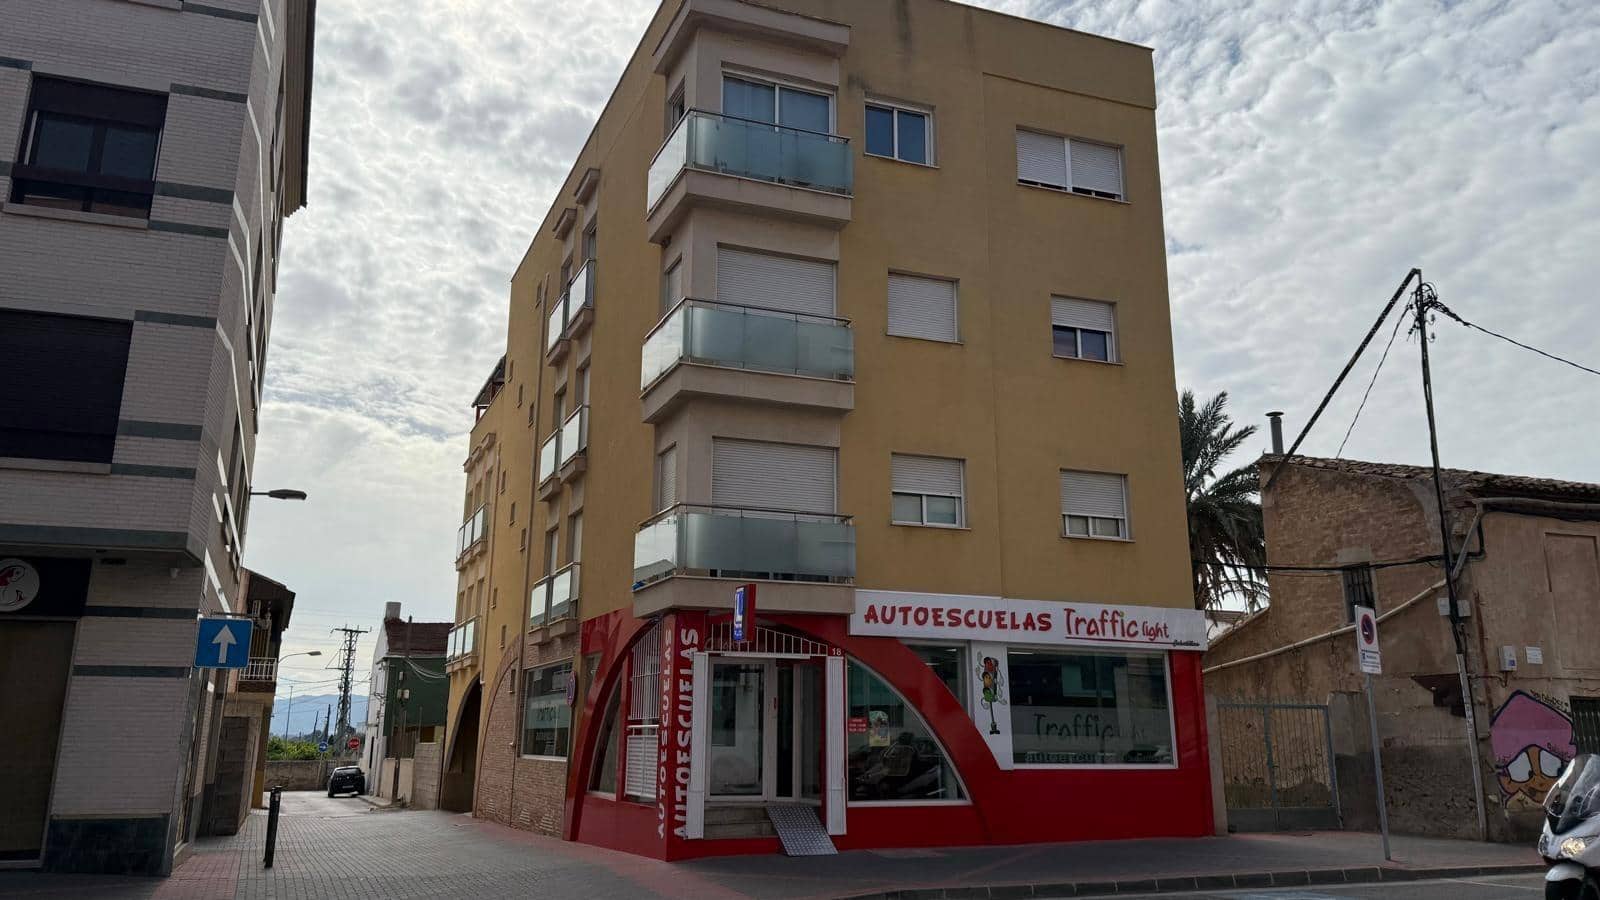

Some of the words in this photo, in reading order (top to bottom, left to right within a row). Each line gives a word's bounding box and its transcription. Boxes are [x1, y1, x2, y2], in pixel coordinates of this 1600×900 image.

[864, 604, 1052, 633] AUTOESCUELAS
[1064, 608, 1139, 638] Traffic
[1142, 620, 1170, 641] light
[832, 647, 842, 656] 18
[658, 628, 672, 839] AUTOESCUELAS
